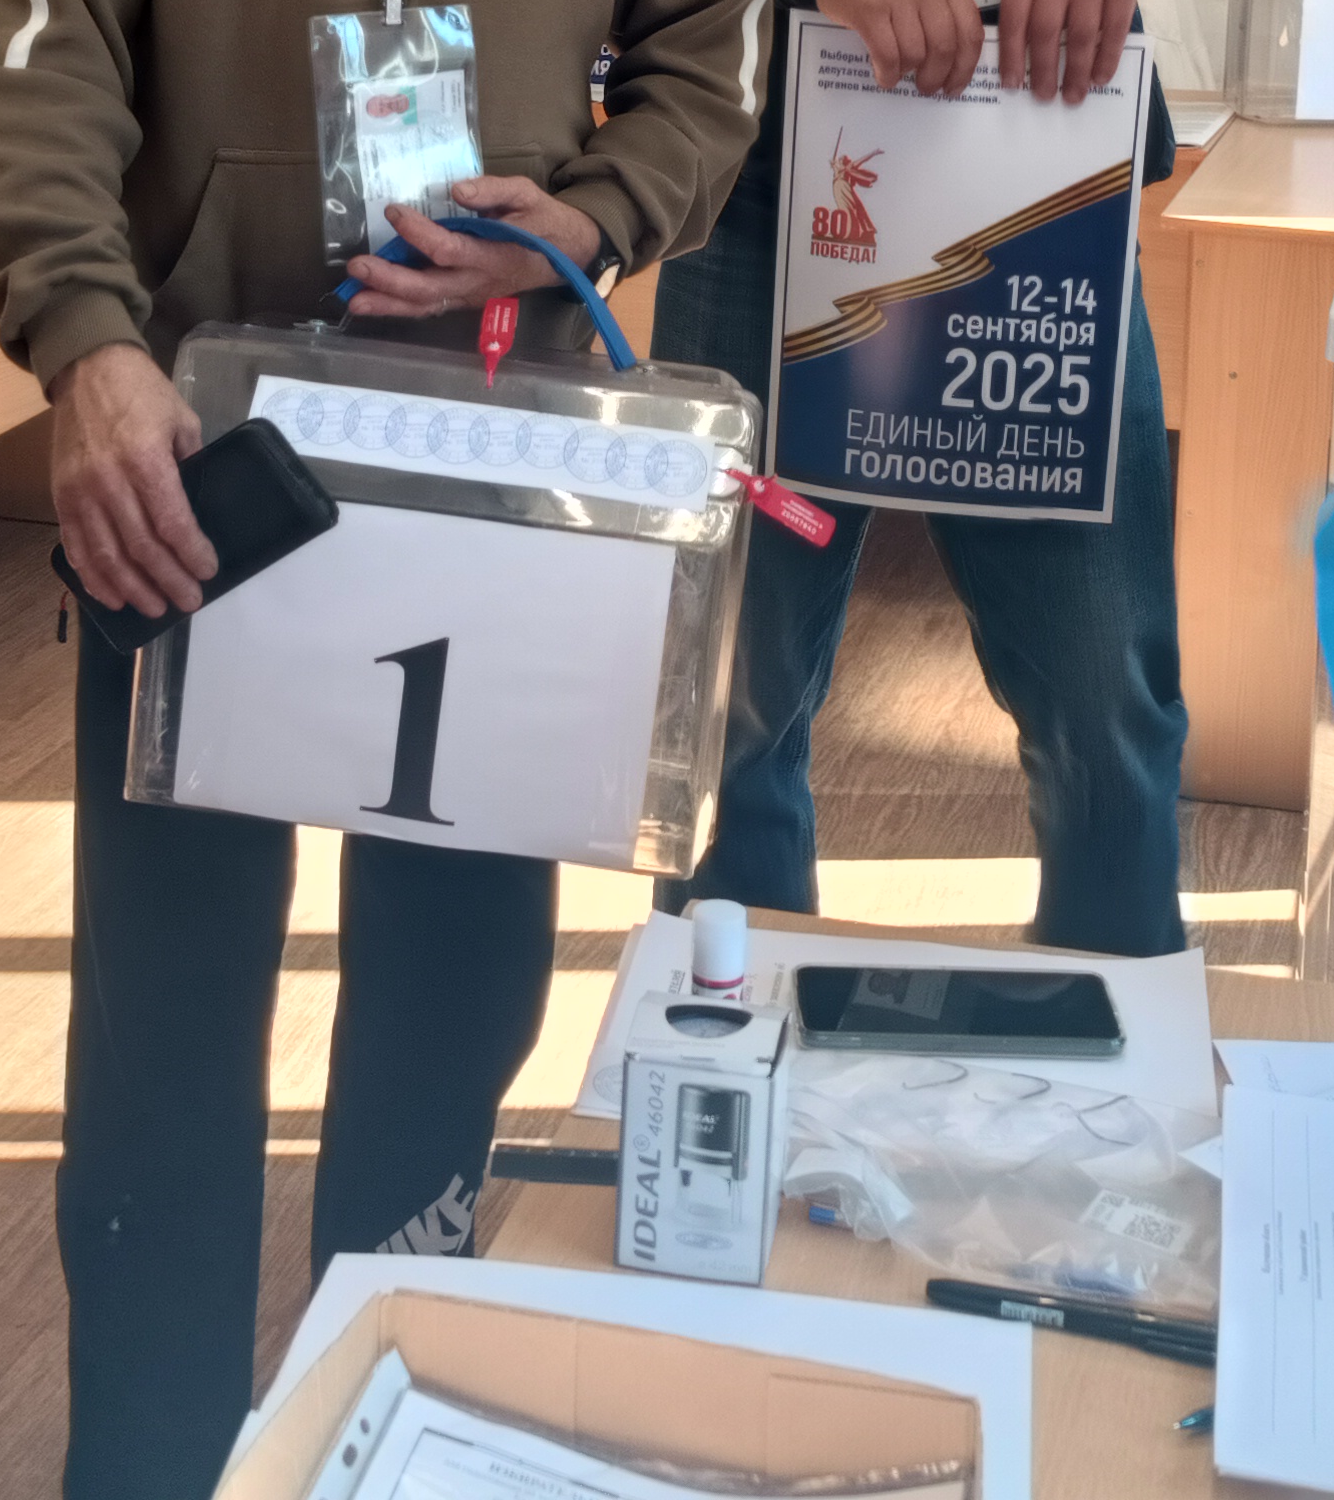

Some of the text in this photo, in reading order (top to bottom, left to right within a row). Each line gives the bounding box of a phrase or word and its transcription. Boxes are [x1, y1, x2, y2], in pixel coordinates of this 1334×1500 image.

[818, 66, 870, 77] депутатов
[820, 49, 863, 63] Выборы
[818, 80, 859, 90] органов
[812, 206, 848, 240] 80
[810, 241, 877, 265] ПОБЕДА!
[1007, 275, 1098, 315] 12-14
[946, 312, 1097, 351] сентября
[941, 347, 1091, 416] 2025
[846, 408, 1086, 461] ЕДИНЫЙ ДЕНЬ
[359, 637, 455, 827] 1
[649, 1070, 667, 1138] 46042
[375, 1172, 480, 1257] IKE
